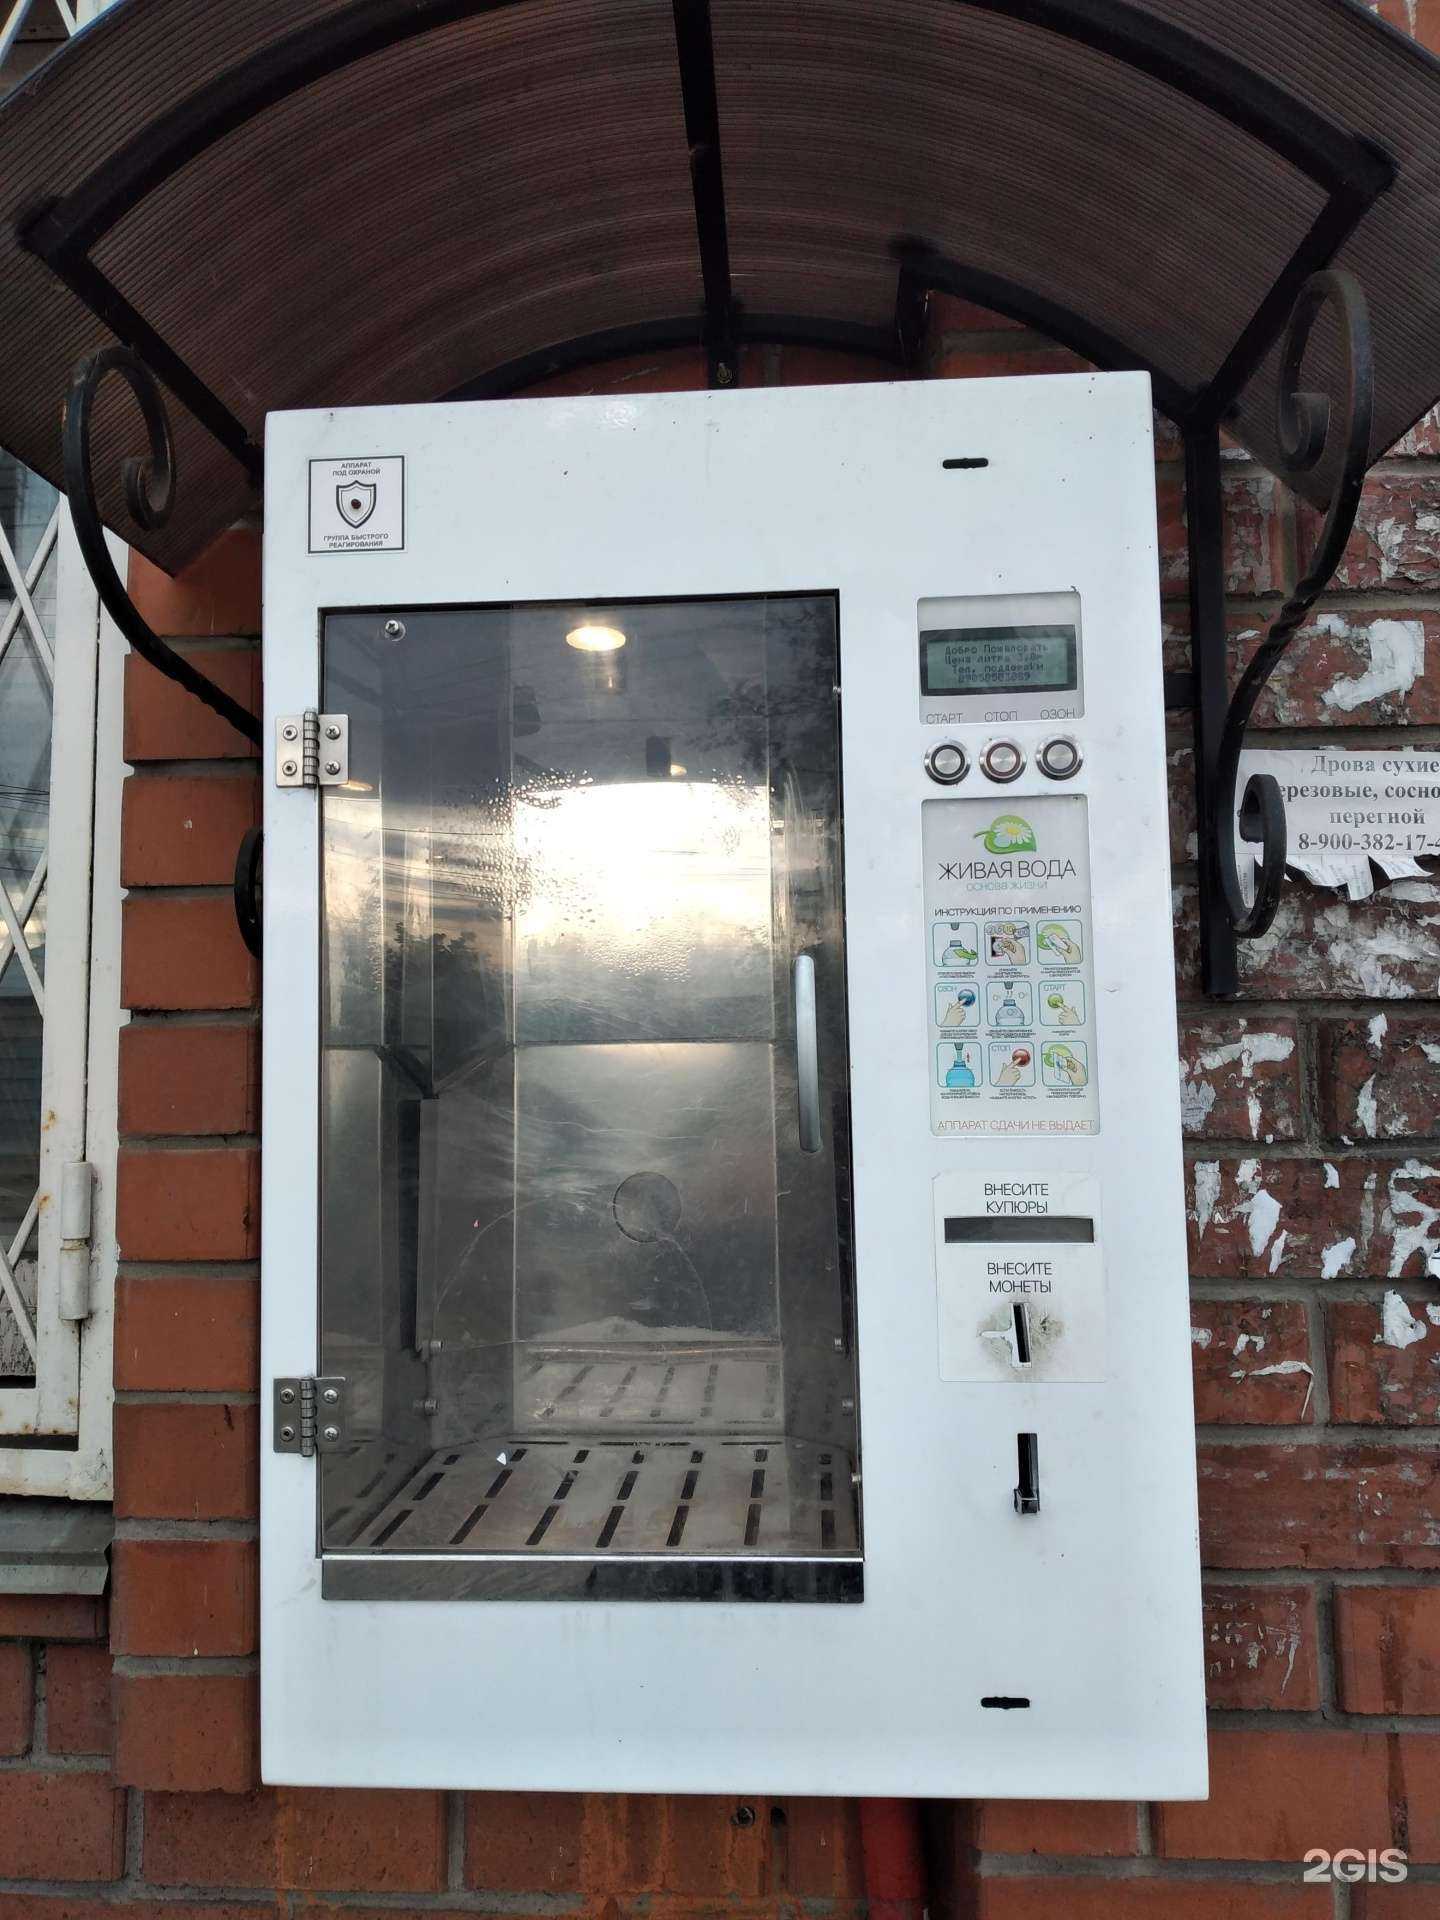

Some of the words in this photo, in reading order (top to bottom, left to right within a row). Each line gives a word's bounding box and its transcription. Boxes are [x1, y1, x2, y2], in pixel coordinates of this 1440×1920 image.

[348, 468, 381, 476] ОХРАНОЙ
[351, 533, 389, 541] БЫСТРОГО
[945, 646, 978, 655] Добро
[945, 655, 971, 664] Цена
[926, 713, 963, 724] СТАРТ
[984, 711, 1018, 722] СТОП
[1040, 707, 1075, 720] ОЗОН
[1311, 755, 1375, 775] Дрова
[1382, 760, 1439, 776] сухие
[1280, 785, 1378, 802] ерезовые,
[1329, 808, 1425, 828] перегной
[938, 861, 1013, 880] ЖИВАЯ
[1018, 859, 1077, 879] ВОДА
[934, 907, 997, 917] ИНСТРУКЦИЯ
[998, 906, 1013, 915] ПО
[1014, 905, 1082, 914] ПРИМЕНЕНИЮ
[938, 1120, 986, 1130] АППАРАТ
[990, 1120, 1030, 1130] СДАЧИ
[1032, 1119, 1048, 1130] НЕ
[1049, 1119, 1094, 1130] ВЫДАЕТ
[984, 1183, 1049, 1196] ВНЕСИТЕ
[986, 1201, 1048, 1214] КУПЮРЫ
[987, 1262, 1052, 1275] ВНЕСИТЕ
[989, 1280, 1051, 1293] МОНЕТЫ
